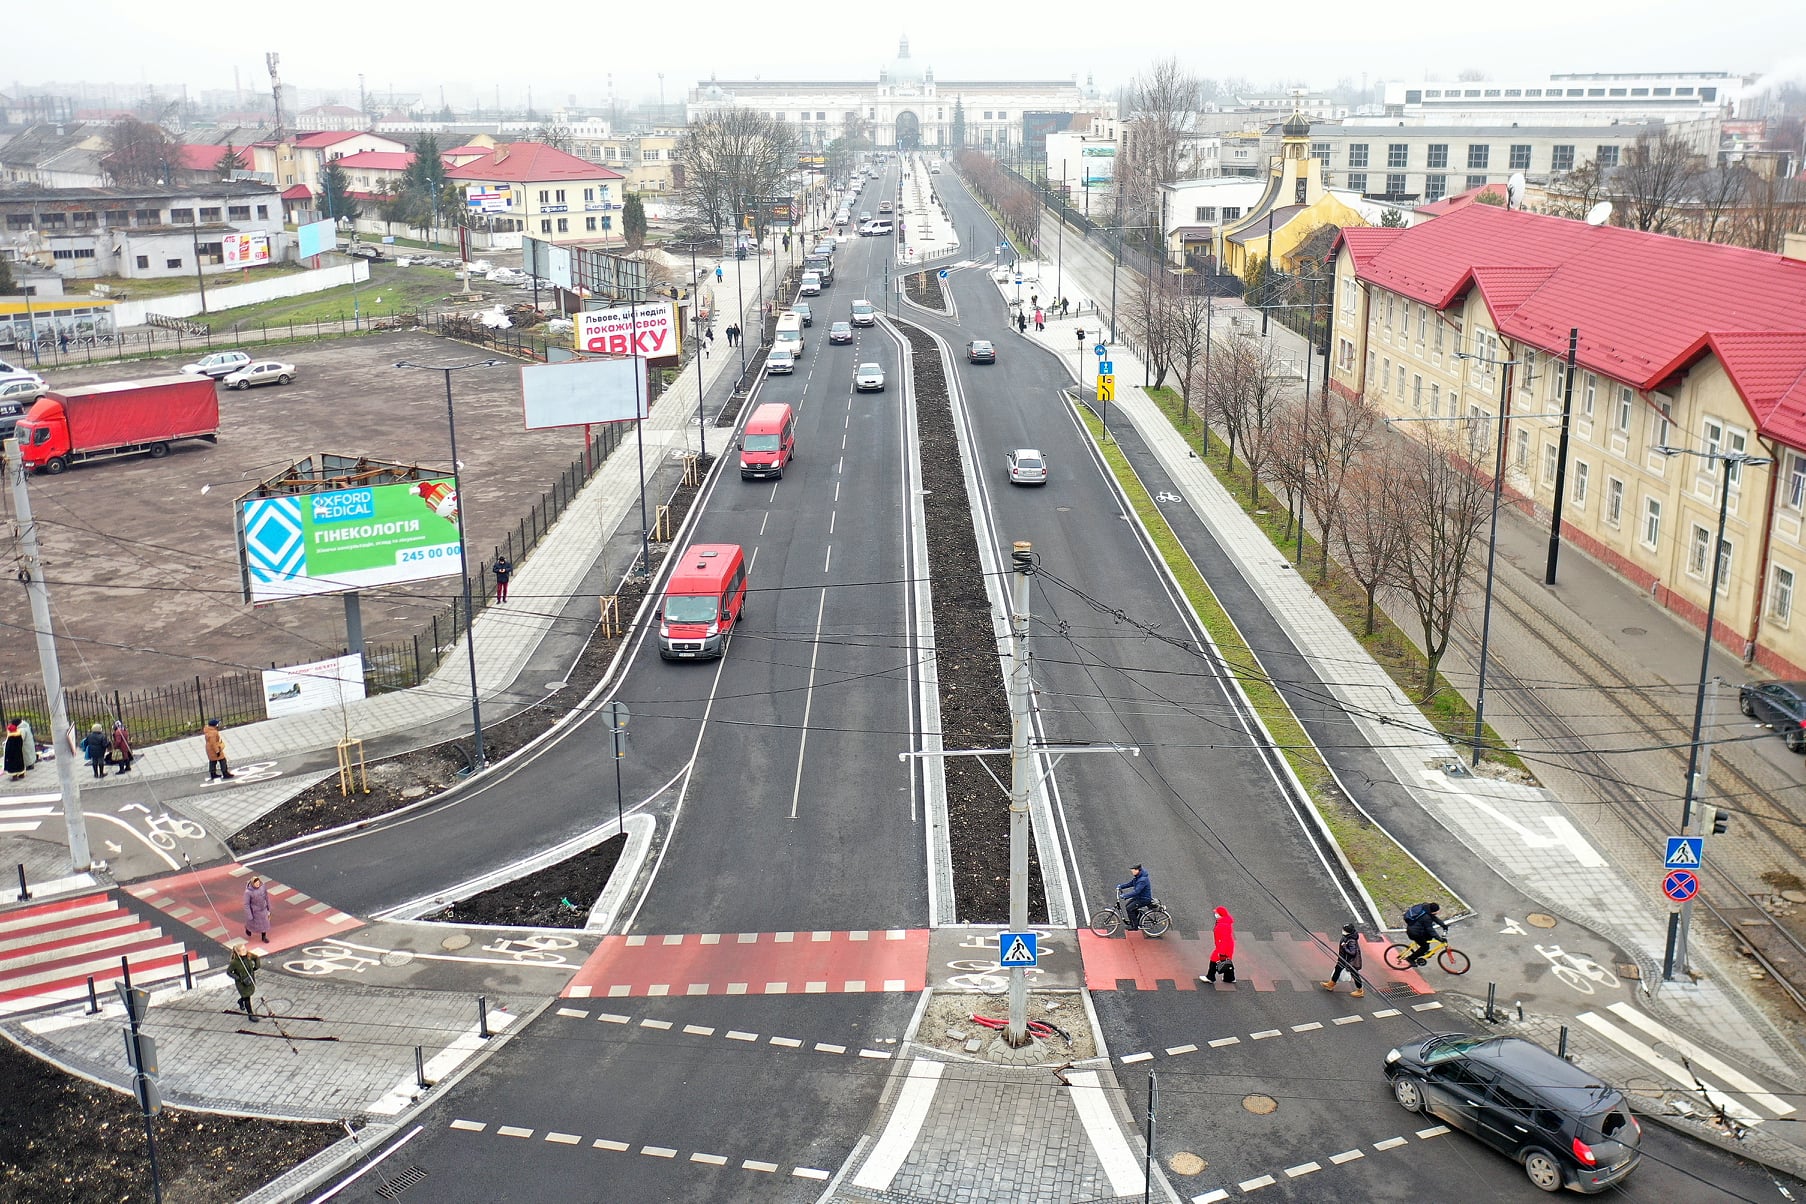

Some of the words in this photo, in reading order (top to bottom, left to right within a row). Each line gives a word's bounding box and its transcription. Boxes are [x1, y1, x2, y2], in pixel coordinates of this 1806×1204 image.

[586, 314, 620, 323] Львове,
[640, 307, 666, 317] неділі
[587, 322, 632, 335] покажи
[636, 318, 667, 329] свою
[588, 328, 667, 354] ЯВКУ
[313, 492, 371, 507] OXFORD
[315, 519, 420, 544] ГІНЕКОЛОГІЯ
[402, 551, 424, 562] 245
[428, 548, 442, 559] 00
[447, 546, 461, 556] 00
